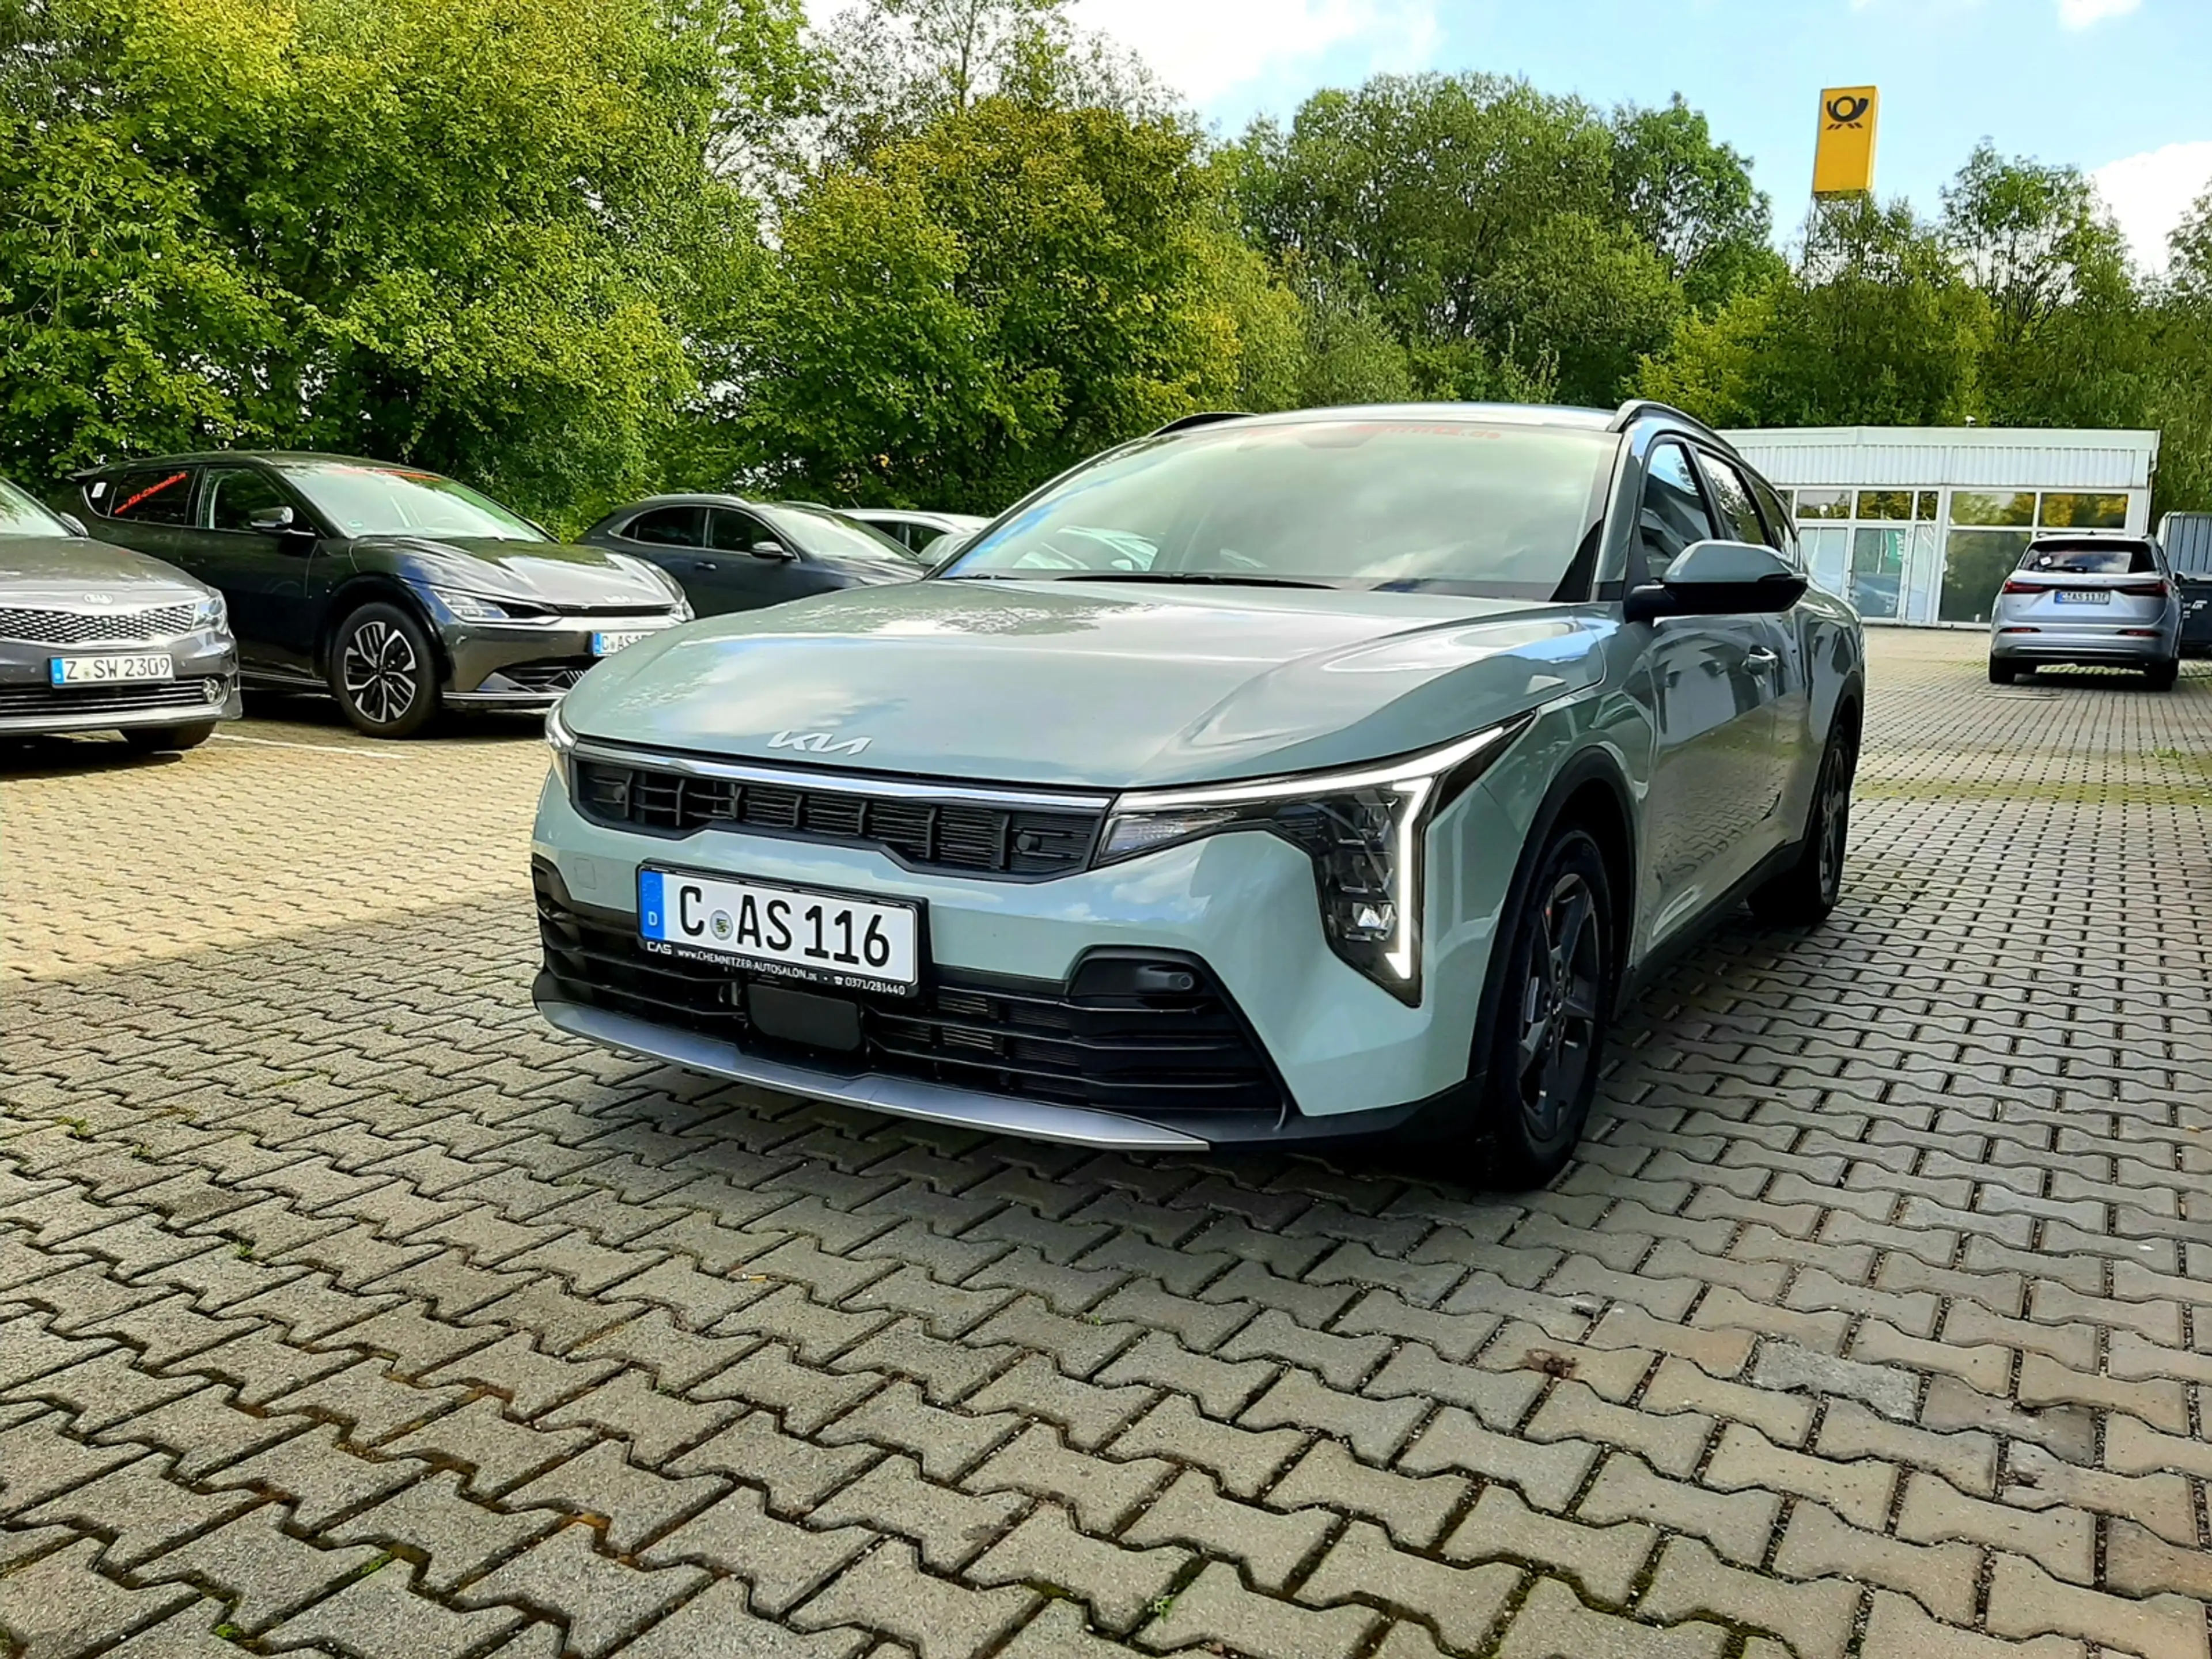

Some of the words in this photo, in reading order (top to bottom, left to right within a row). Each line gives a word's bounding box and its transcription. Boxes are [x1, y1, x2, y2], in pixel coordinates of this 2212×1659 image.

[602, 635, 609, 650] C
[65, 661, 79, 680] Z
[93, 659, 118, 679] SW
[124, 657, 170, 677] 2309
[648, 911, 658, 926] D
[680, 885, 705, 936] C
[736, 895, 793, 951] AS
[804, 906, 889, 967] 116
